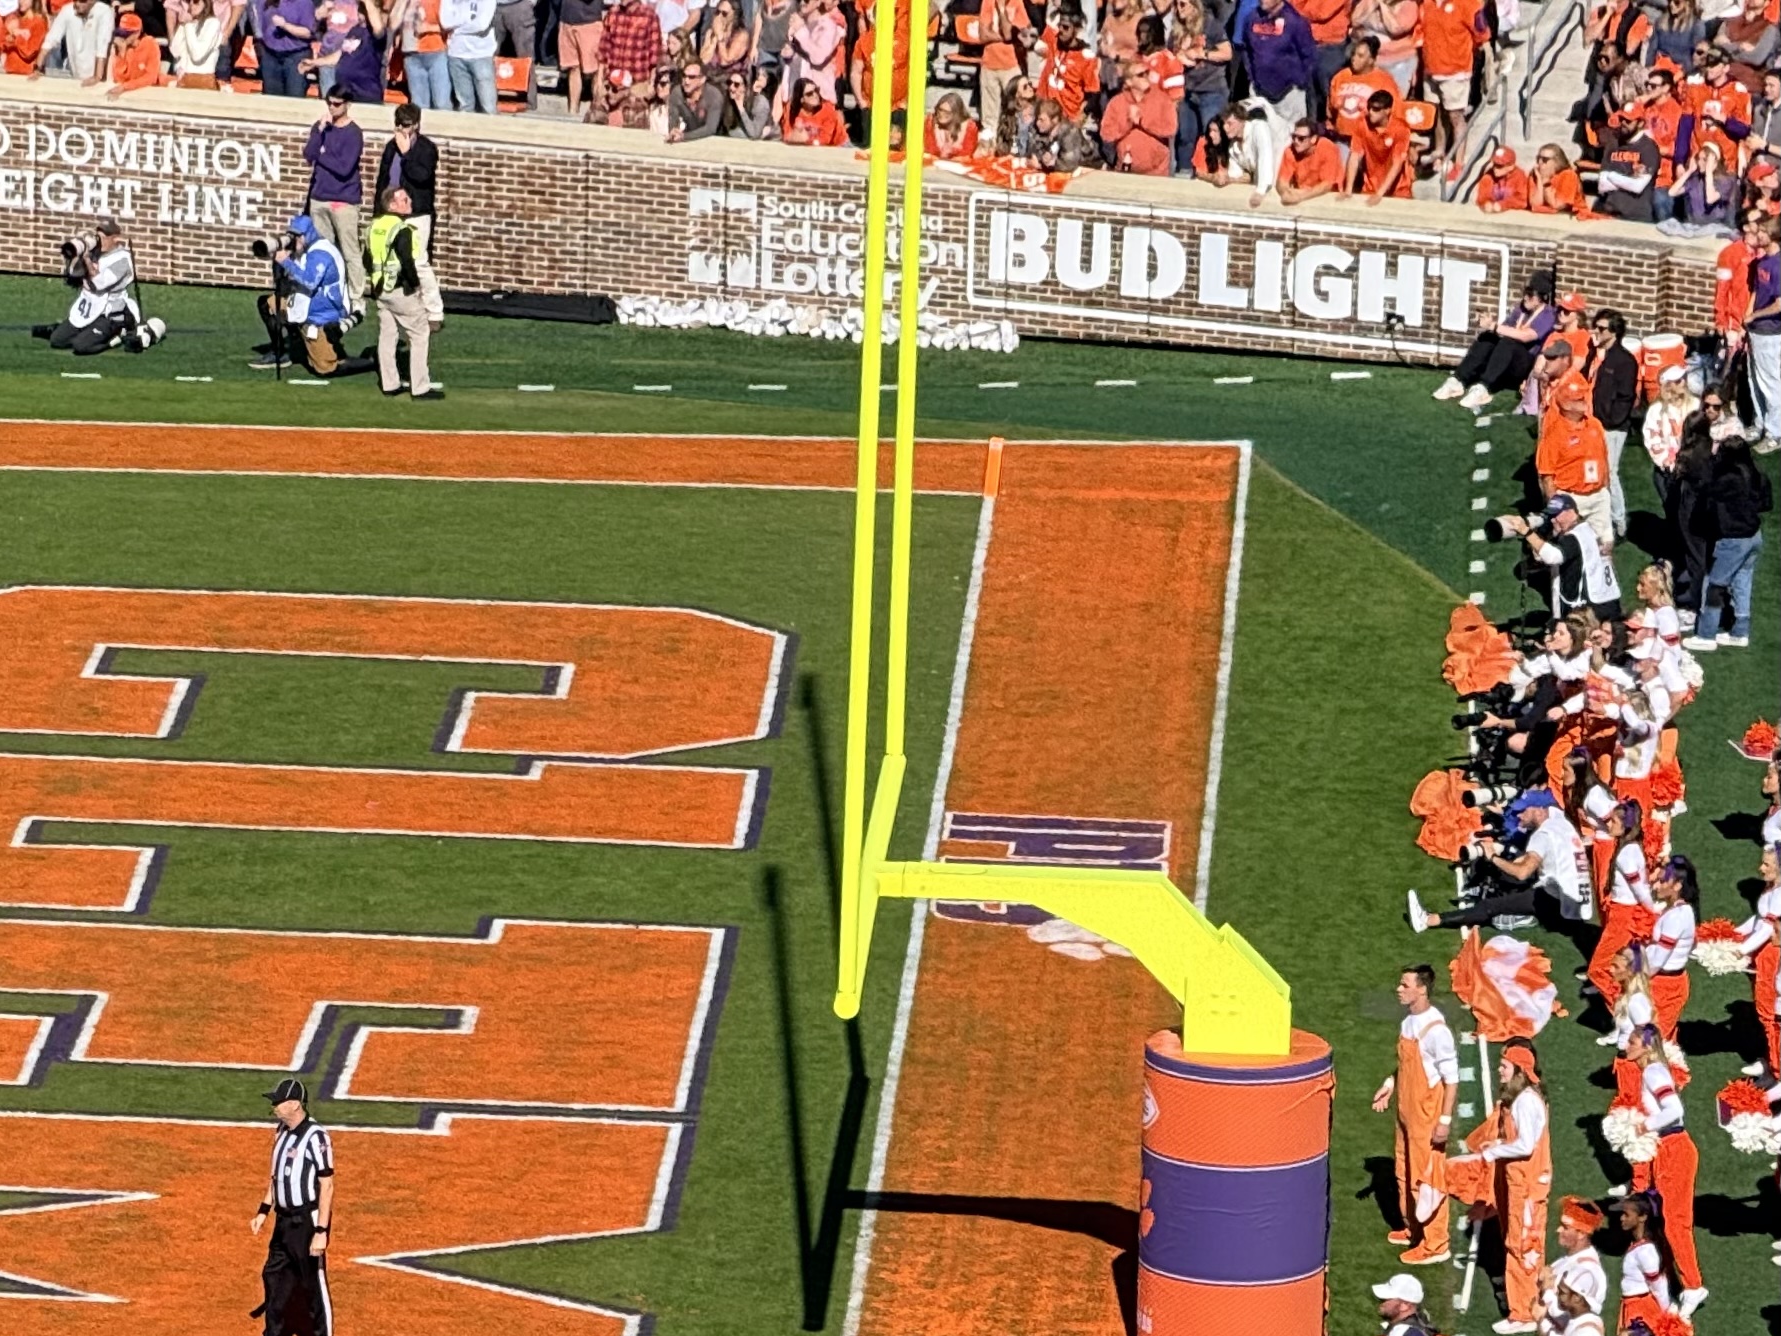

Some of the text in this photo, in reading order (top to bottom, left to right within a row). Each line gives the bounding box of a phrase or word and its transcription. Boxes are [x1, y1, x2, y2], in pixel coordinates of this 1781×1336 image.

[25, 123, 283, 182] DOMINION
[158, 183, 266, 228] LINE
[763, 196, 835, 223] South
[763, 218, 964, 268] Educton
[987, 211, 1487, 333] BUD LIGHT
